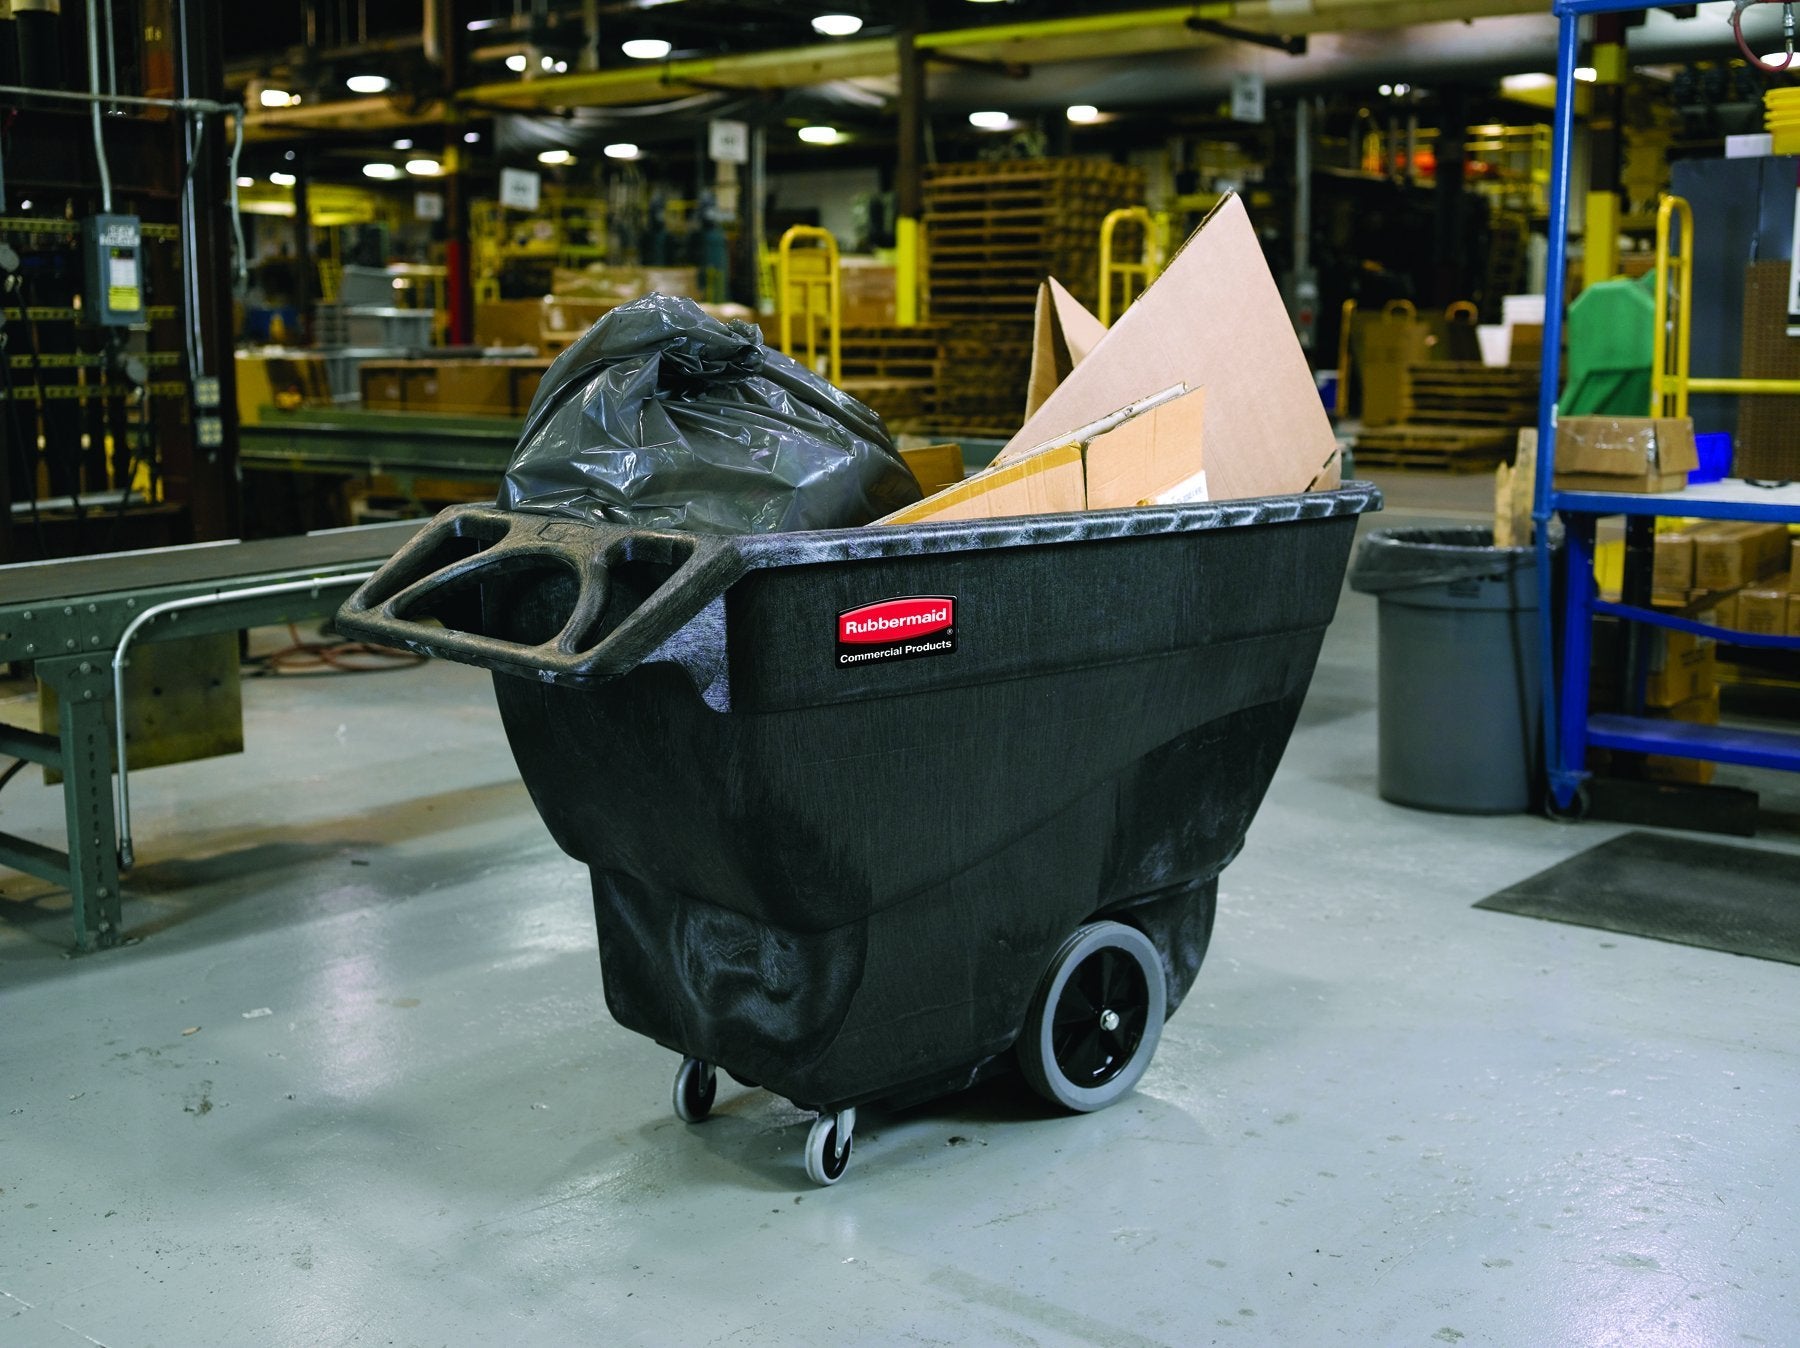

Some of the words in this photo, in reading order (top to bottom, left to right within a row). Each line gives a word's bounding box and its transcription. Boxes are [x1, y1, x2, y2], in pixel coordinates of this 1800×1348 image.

[845, 607, 947, 635] Rubbermaid
[840, 646, 902, 663] Commercial
[905, 640, 952, 654] Products
